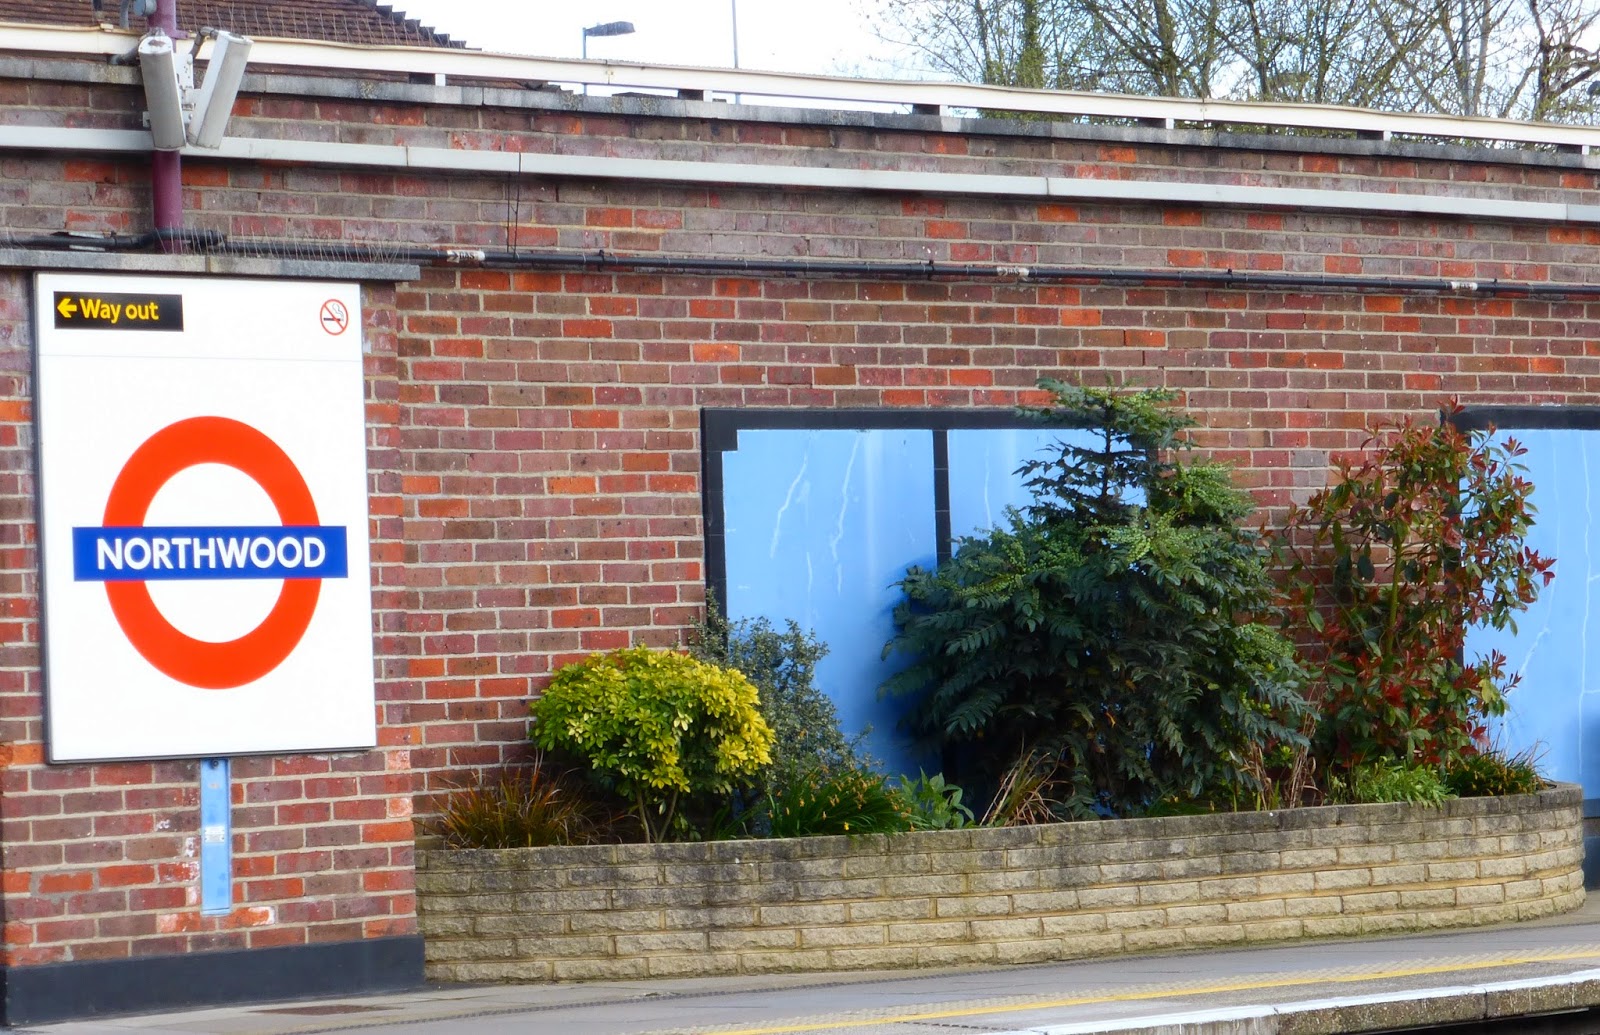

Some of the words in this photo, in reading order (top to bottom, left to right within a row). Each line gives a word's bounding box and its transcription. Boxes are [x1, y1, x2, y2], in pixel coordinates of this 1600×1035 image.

[79, 298, 121, 324] Way
[125, 302, 159, 320] out
[97, 536, 326, 570] NORTHWOOD
